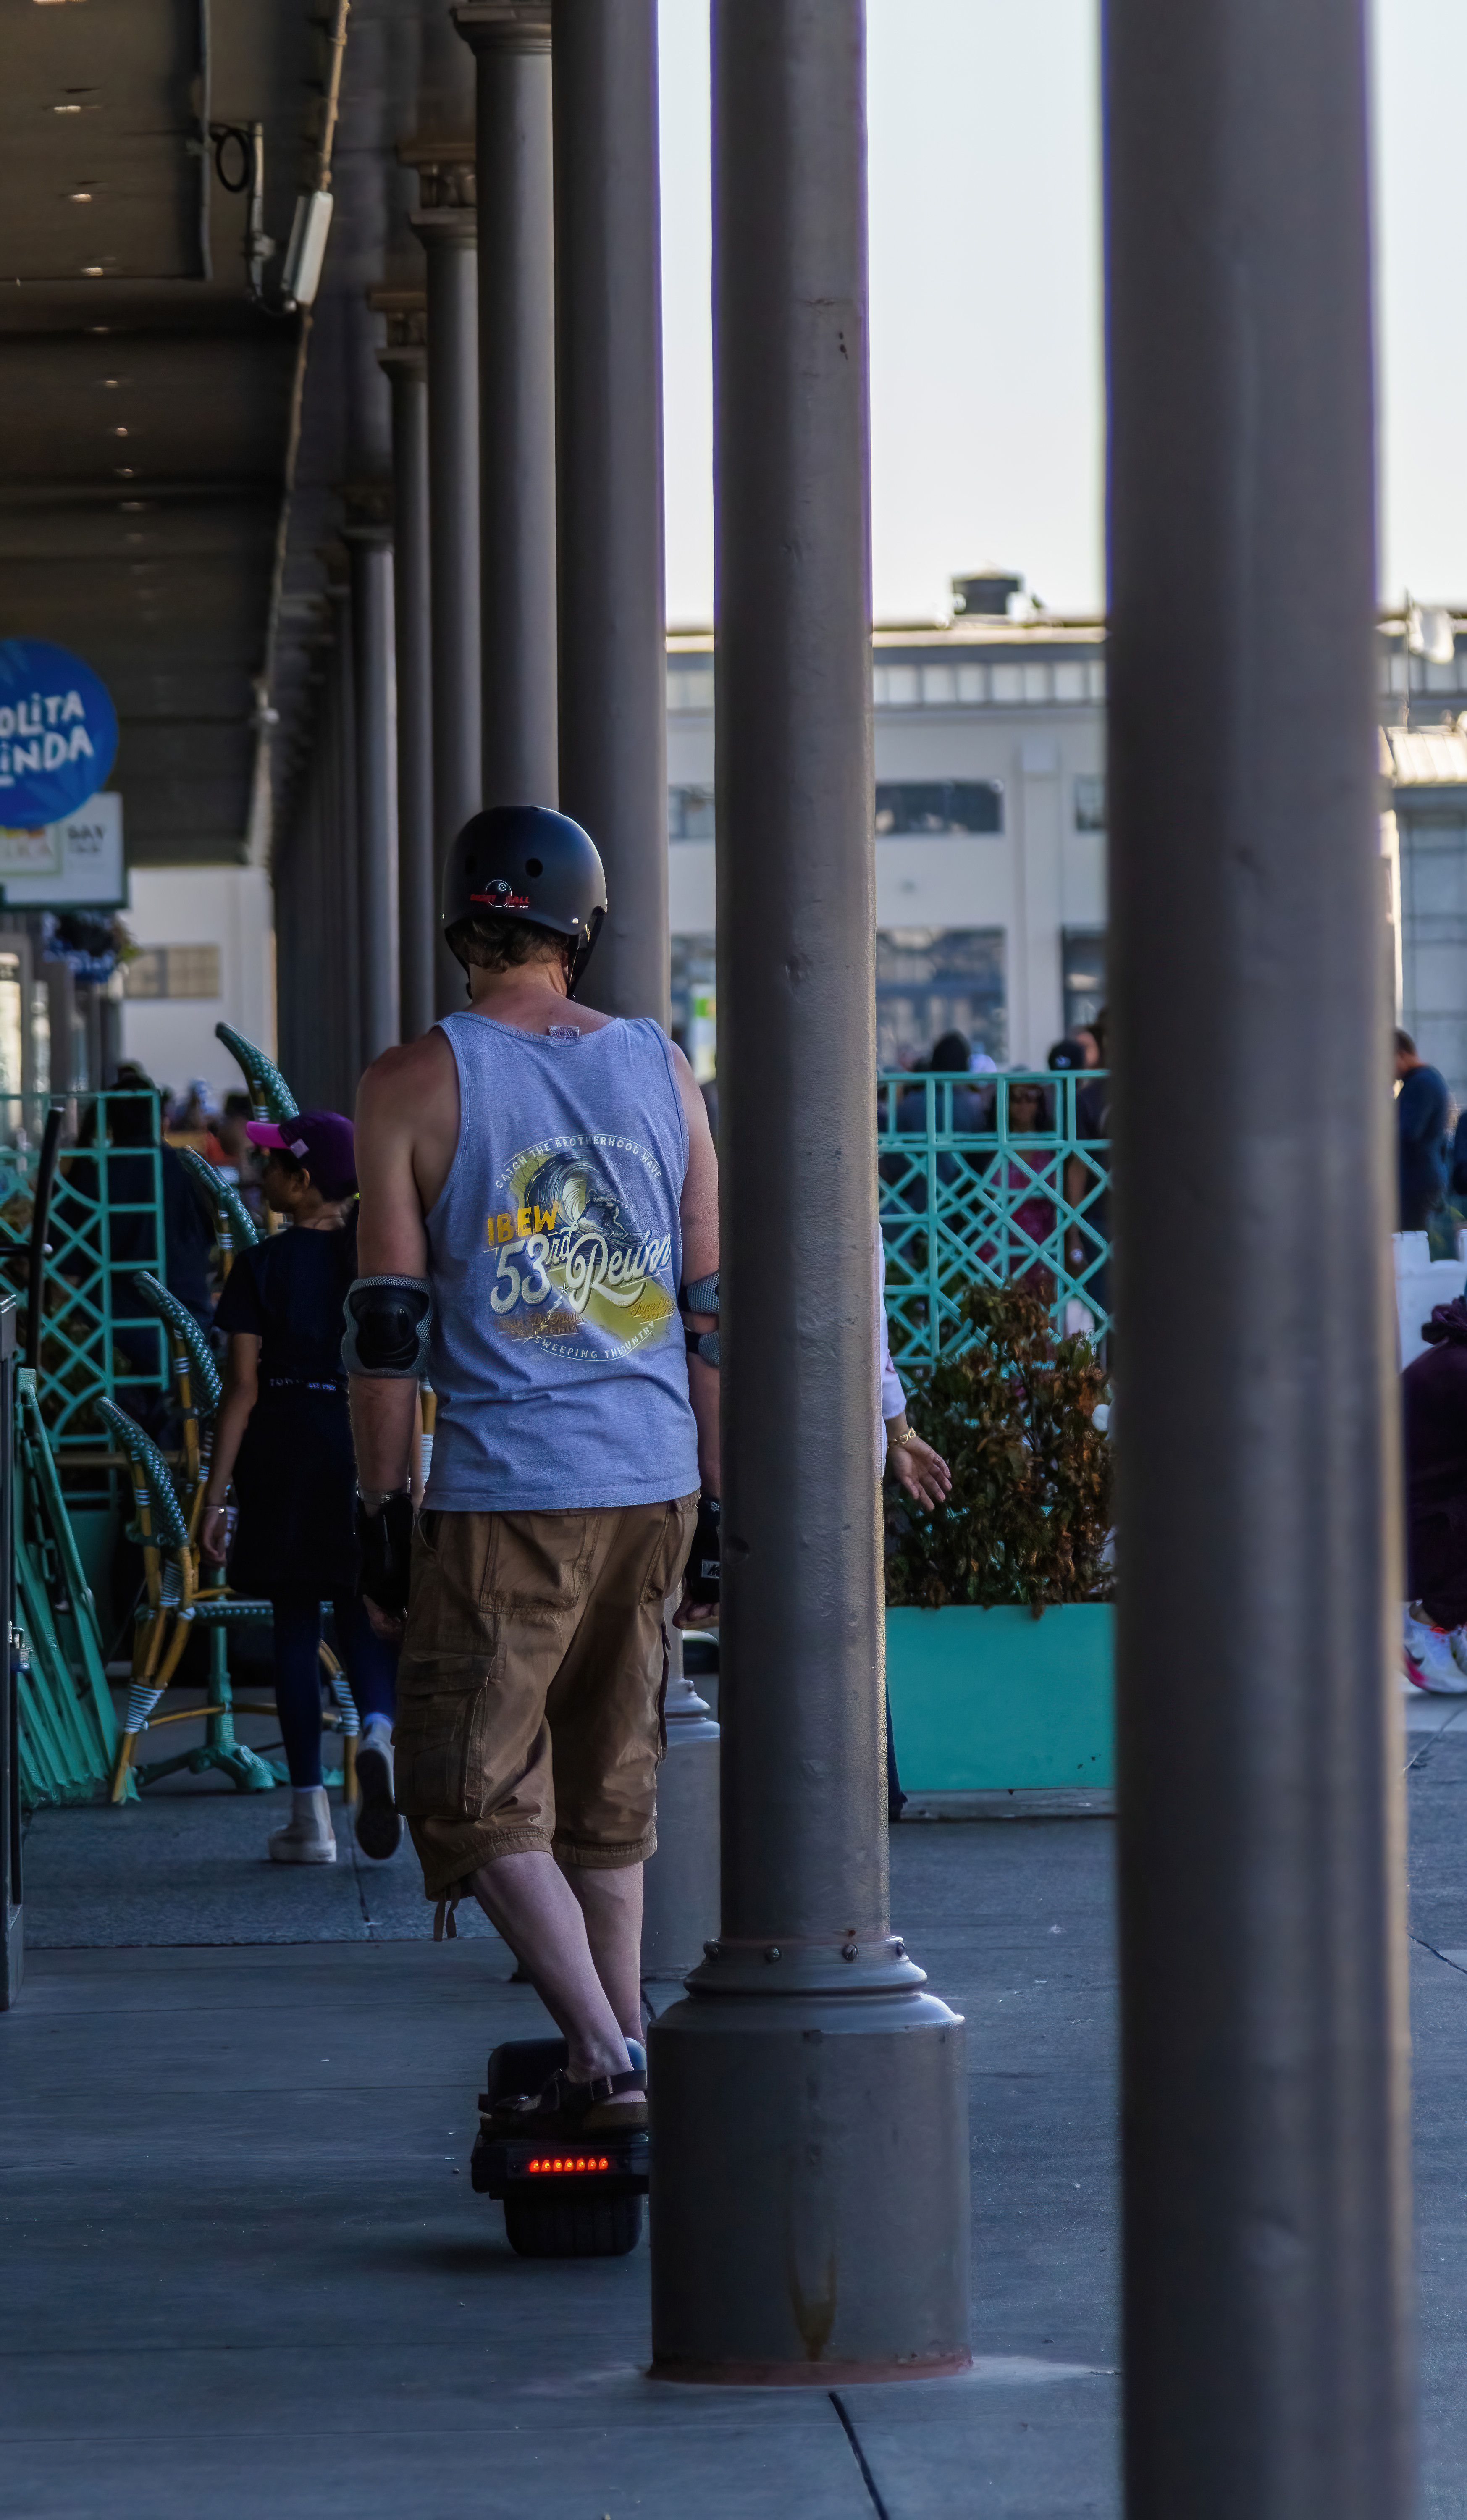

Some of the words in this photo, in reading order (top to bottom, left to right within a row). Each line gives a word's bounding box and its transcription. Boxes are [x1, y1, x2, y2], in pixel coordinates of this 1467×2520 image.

[496, 1156, 528, 1188] CATCH
[529, 1142, 552, 1158] THE
[555, 1135, 639, 1154] BROTHERHOOD
[641, 1152, 662, 1179] WAVE
[488, 1201, 559, 1247] IBEW
[490, 1221, 579, 1314] 53rd
[534, 1336, 598, 1358] SWEEPING
[621, 1320, 655, 1354] OUNTRY
